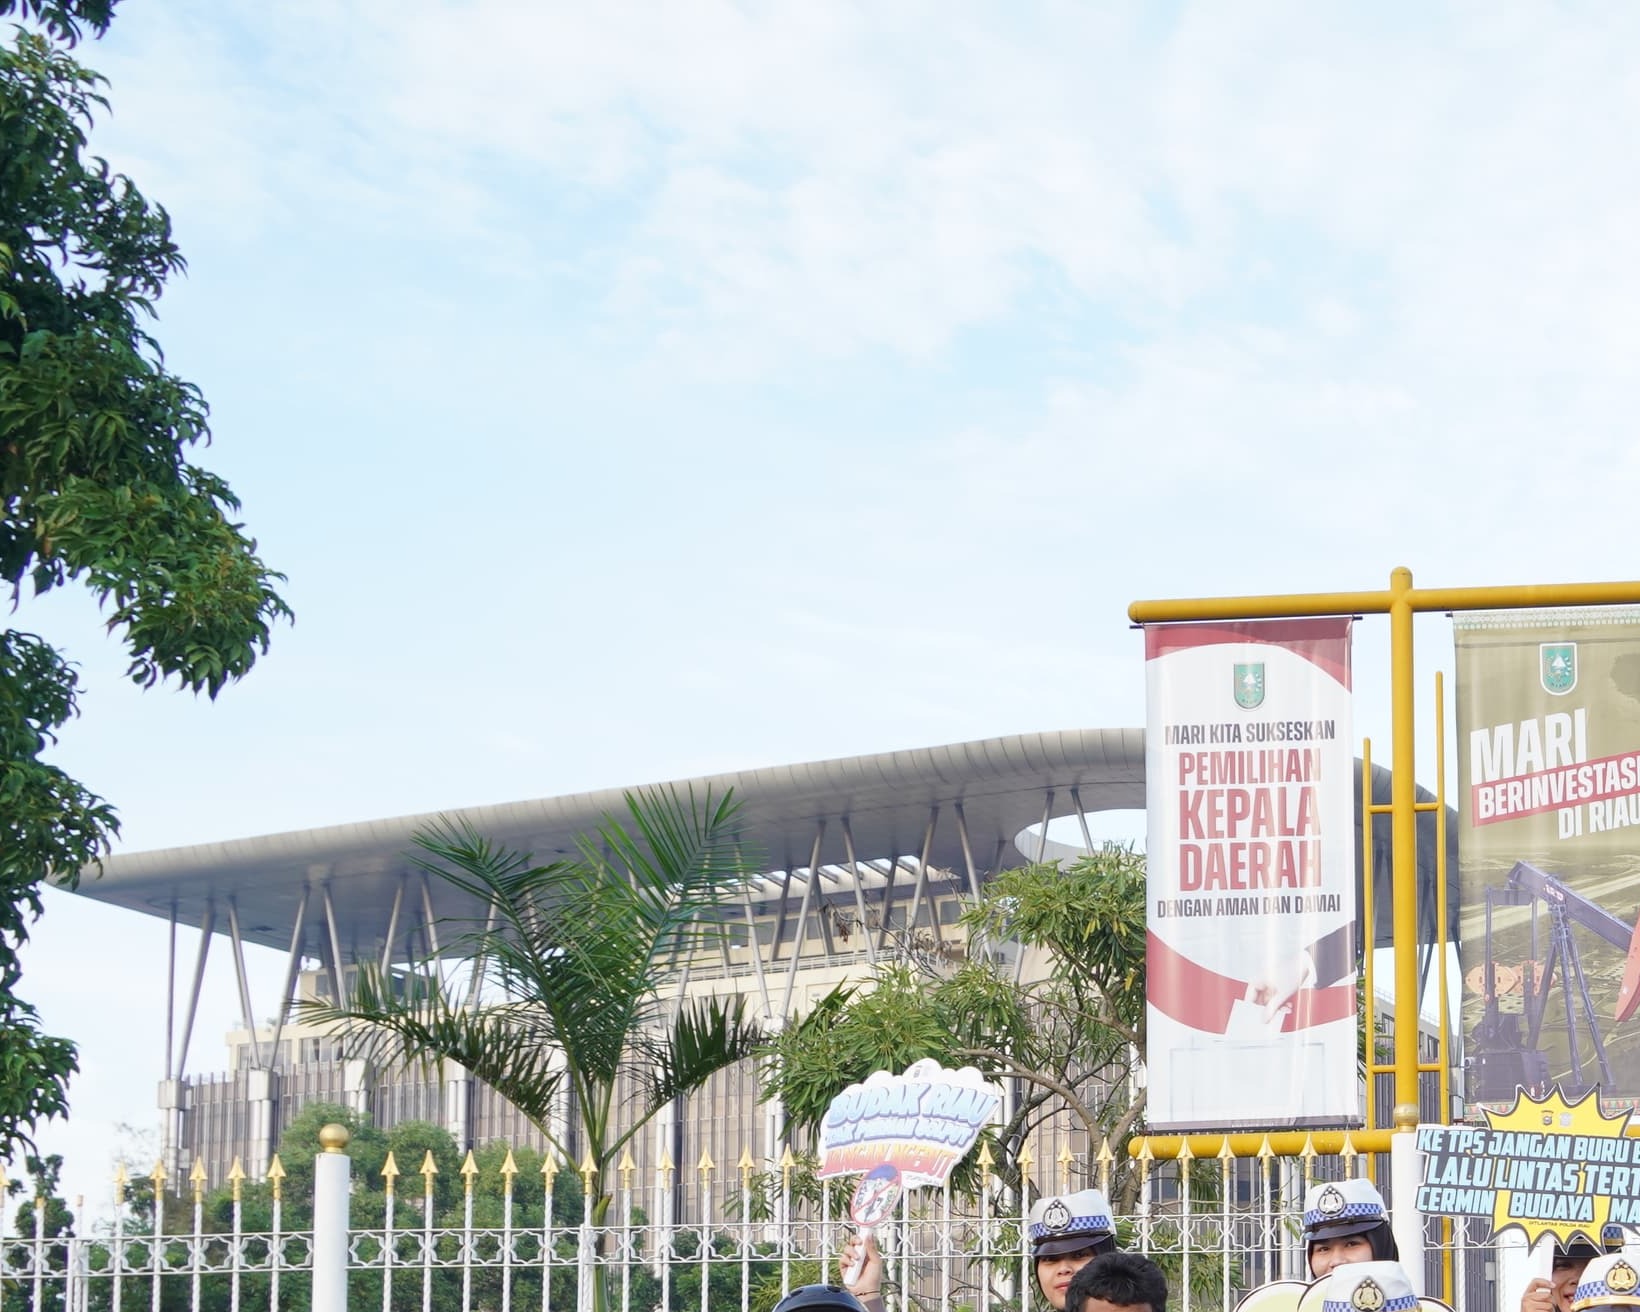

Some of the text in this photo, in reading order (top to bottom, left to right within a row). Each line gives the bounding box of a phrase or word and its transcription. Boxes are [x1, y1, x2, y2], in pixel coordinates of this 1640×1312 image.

[1165, 719, 1335, 745] MARI KITA SUKSESKAN
[1470, 707, 1587, 785] MARI
[1179, 748, 1321, 786] PEMILIHAN
[1179, 785, 1322, 840] KEPALA
[1558, 805, 1582, 840] DI
[1179, 839, 1322, 892] DAERAH
[1157, 894, 1341, 918] DENGAN AMAN DAN DAMAI
[1418, 1129, 1443, 1152] KE
[1449, 1130, 1486, 1155] TPS
[1487, 1132, 1571, 1161] JANGAN
[1572, 1136, 1630, 1164] BURU
[1428, 1154, 1493, 1188] LALU
[1494, 1158, 1580, 1193] LINTAS
[1417, 1186, 1496, 1215] CERMIN
[1510, 1192, 1595, 1222] BUDAYA
